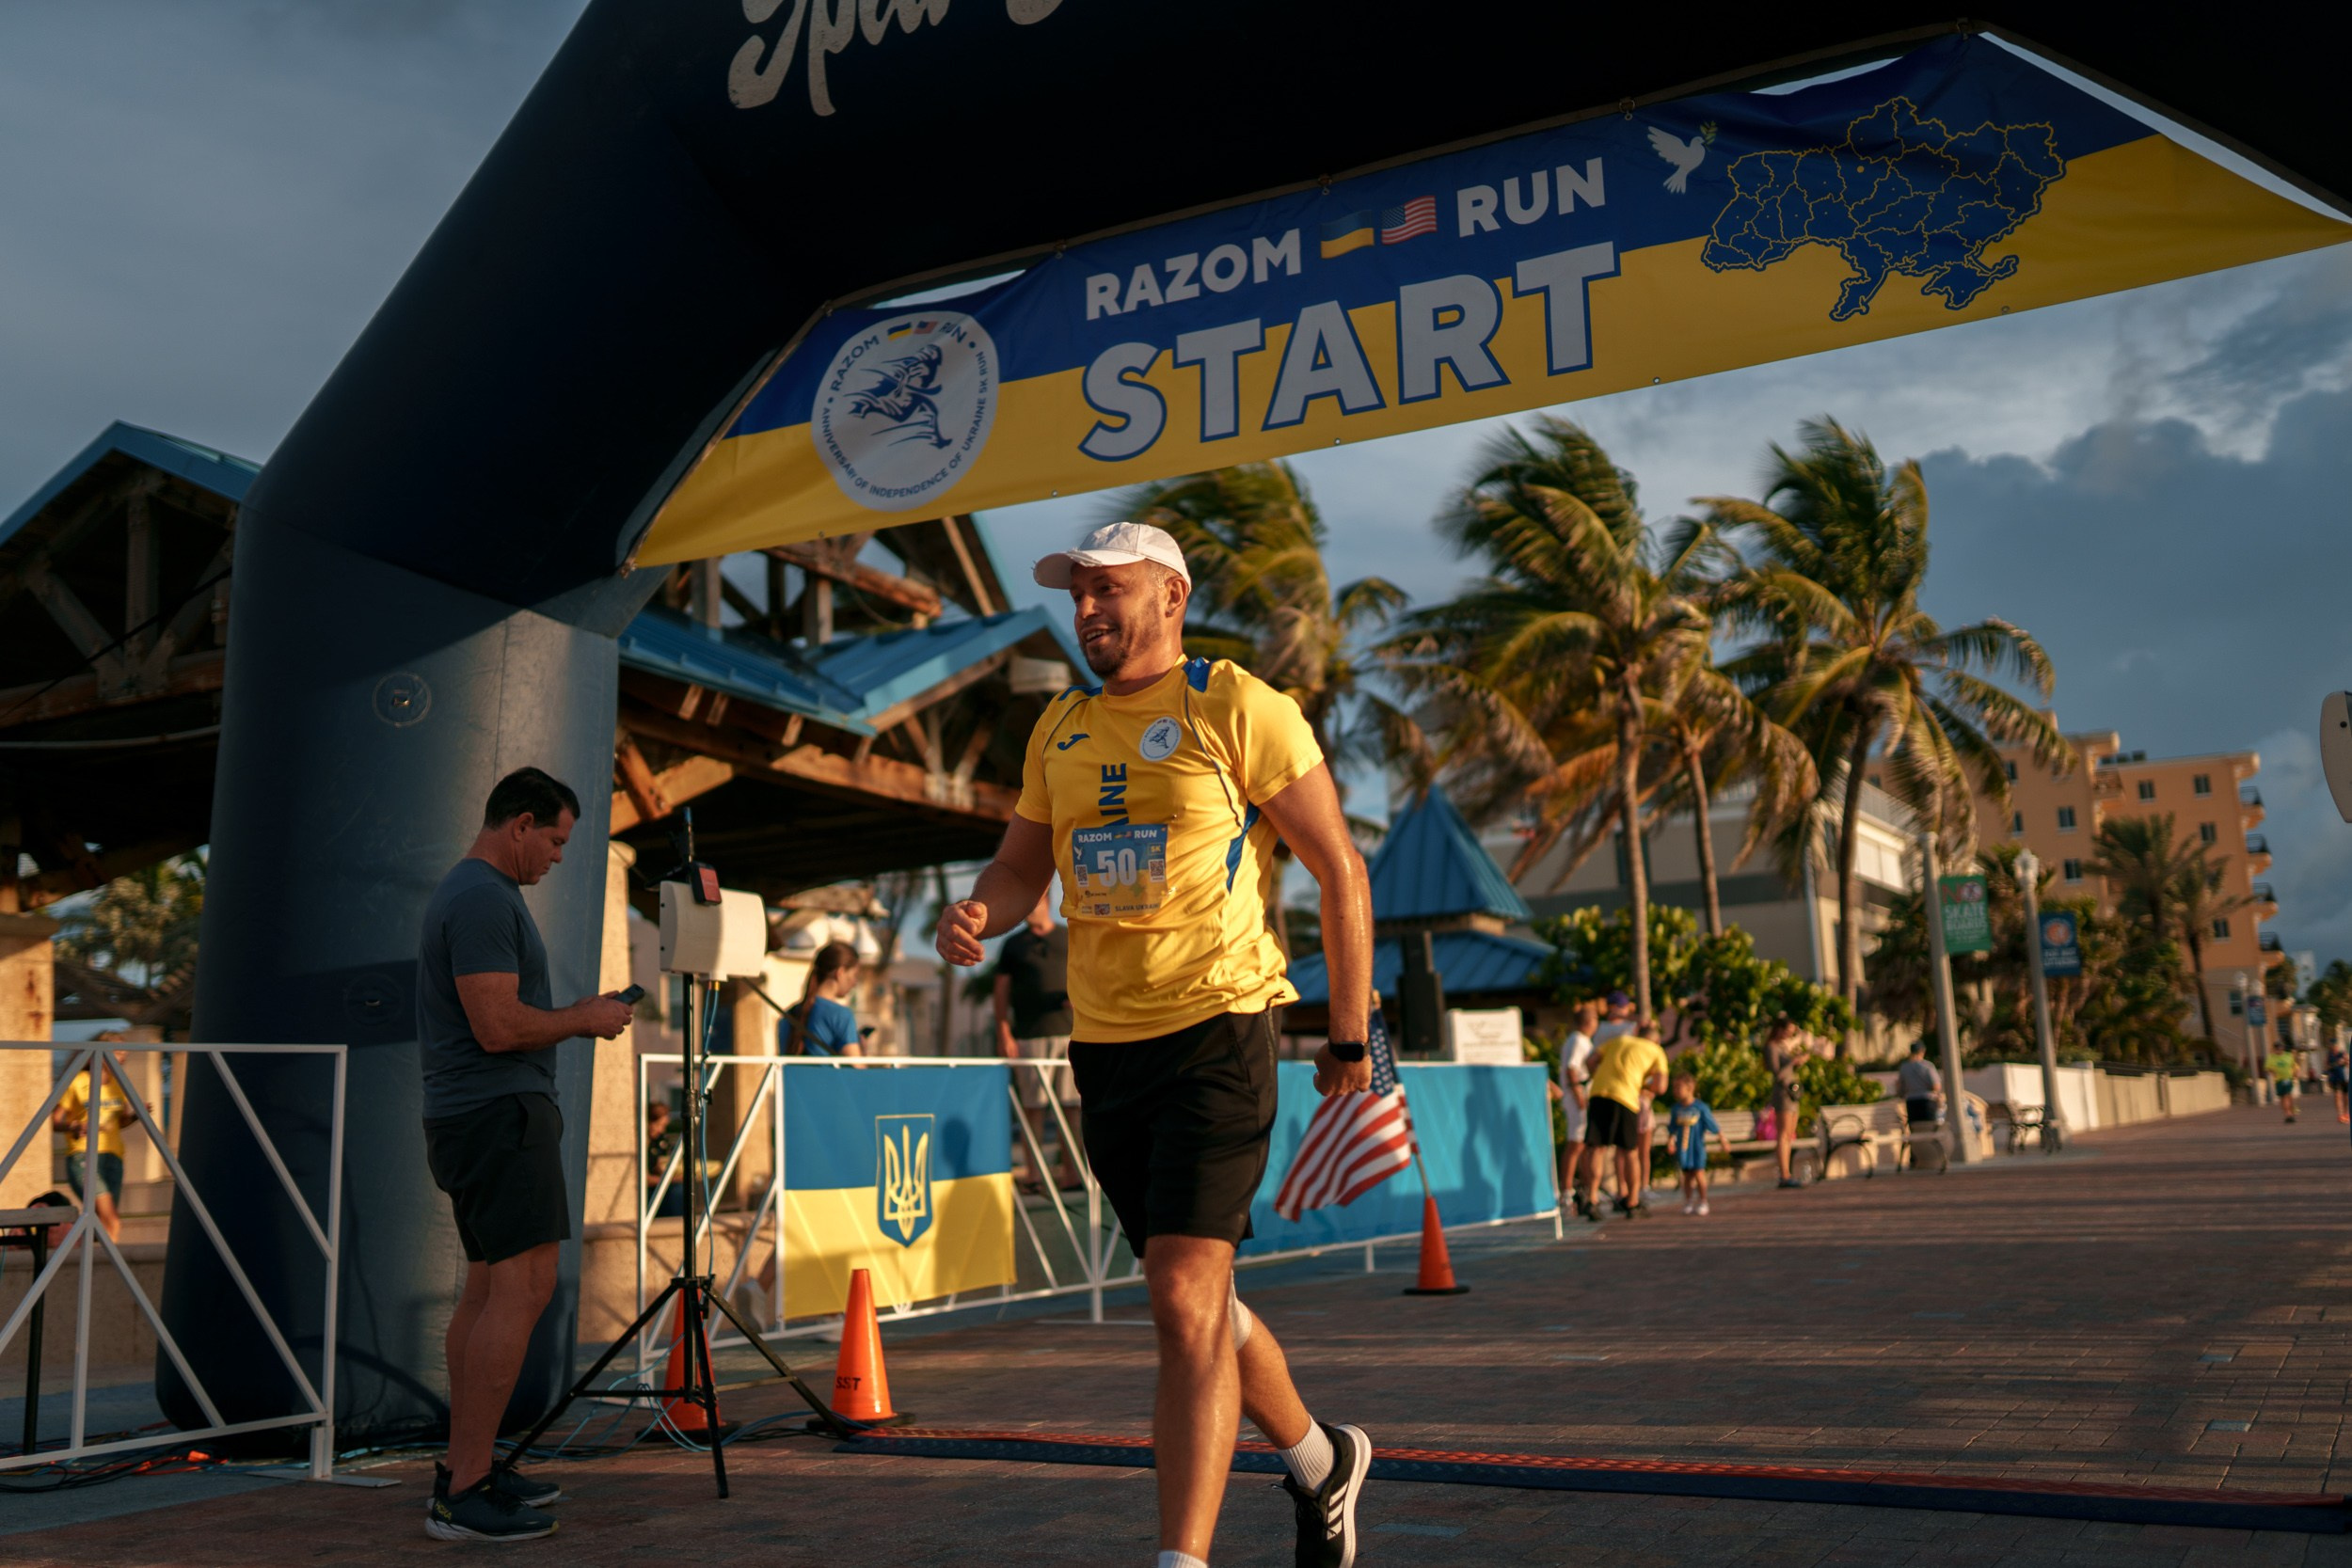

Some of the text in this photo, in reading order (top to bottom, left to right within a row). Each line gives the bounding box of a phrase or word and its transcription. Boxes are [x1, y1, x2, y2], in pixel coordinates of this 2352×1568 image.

[1086, 157, 1605, 321] RAZOM RUN
[830, 335, 880, 391] RAZOM
[1078, 241, 1621, 462] START
[822, 407, 857, 479] ANNIVERSARY
[854, 477, 868, 489] OF
[869, 468, 948, 499] INDEPENDENCE
[948, 451, 961, 468] OF
[961, 397, 986, 451] UKRAINE
[976, 351, 988, 375] RUN
[1078, 830, 1157, 843] RAZOM RUN
[1097, 847, 1137, 887] 50
